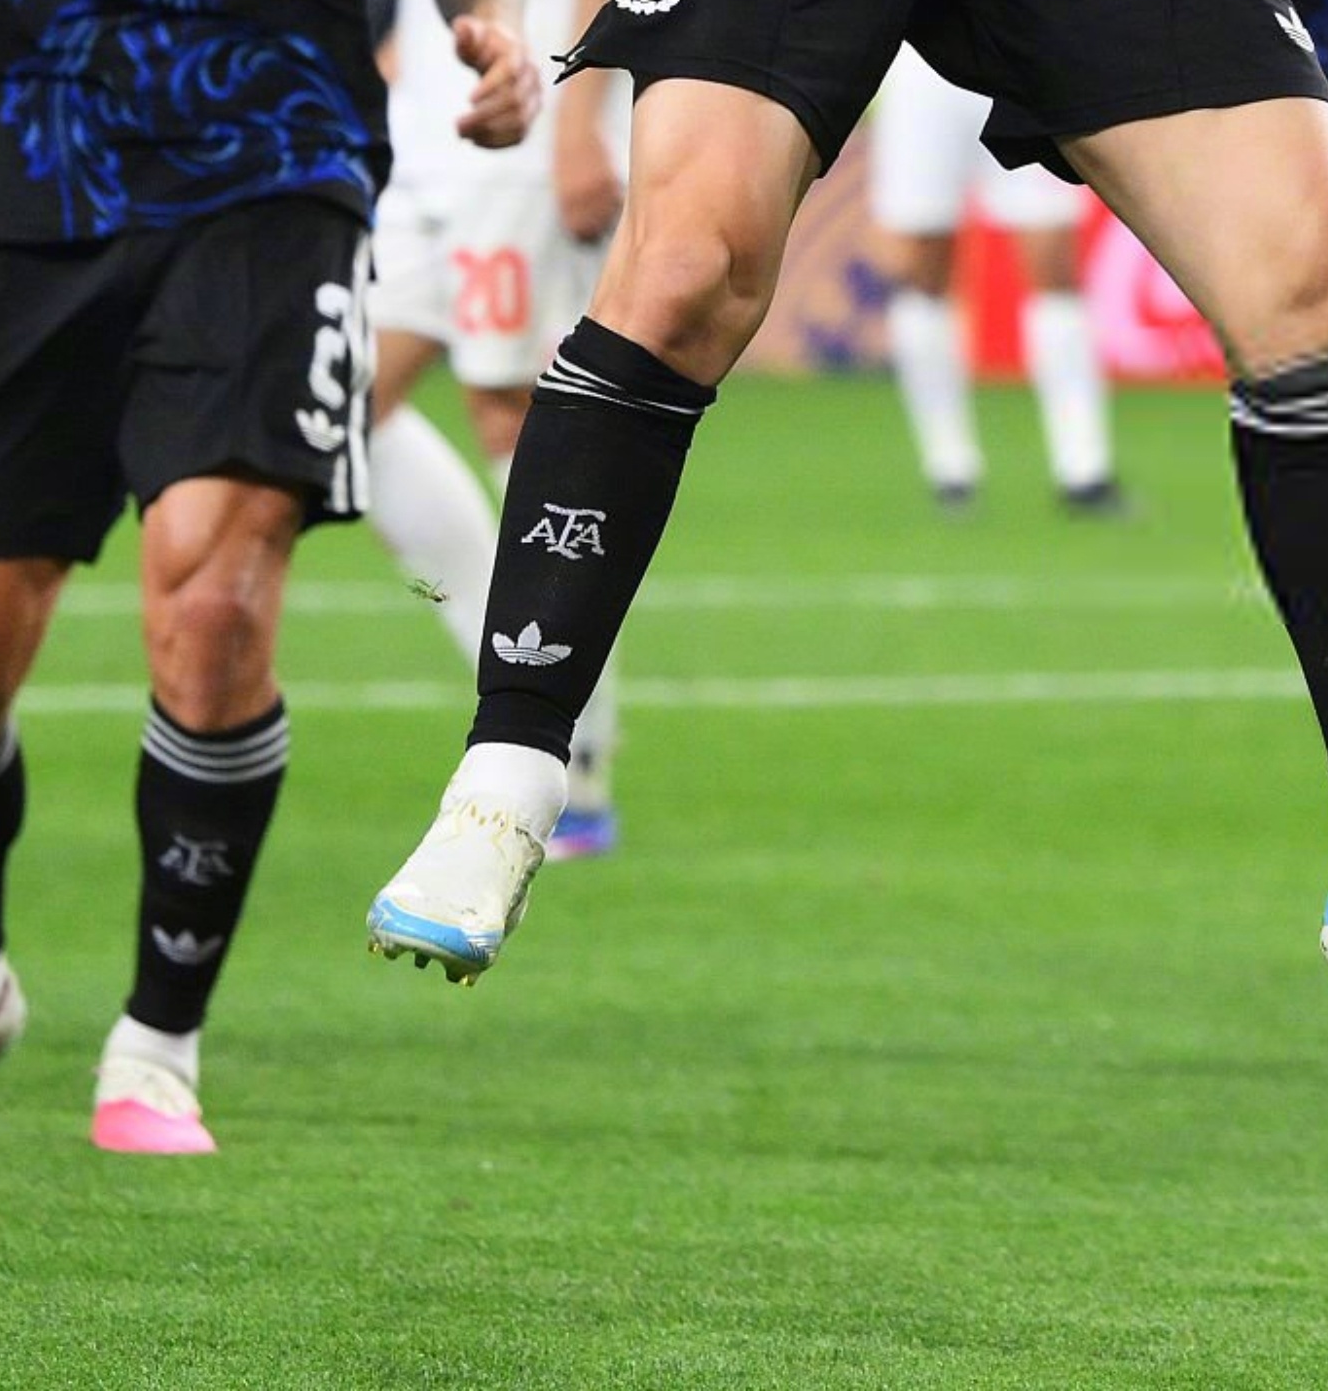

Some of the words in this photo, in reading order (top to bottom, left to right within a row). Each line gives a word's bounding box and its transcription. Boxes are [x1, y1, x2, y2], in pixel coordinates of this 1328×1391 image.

[451, 246, 531, 336] 20
[308, 281, 352, 409] 2
[521, 502, 607, 560] AFA
